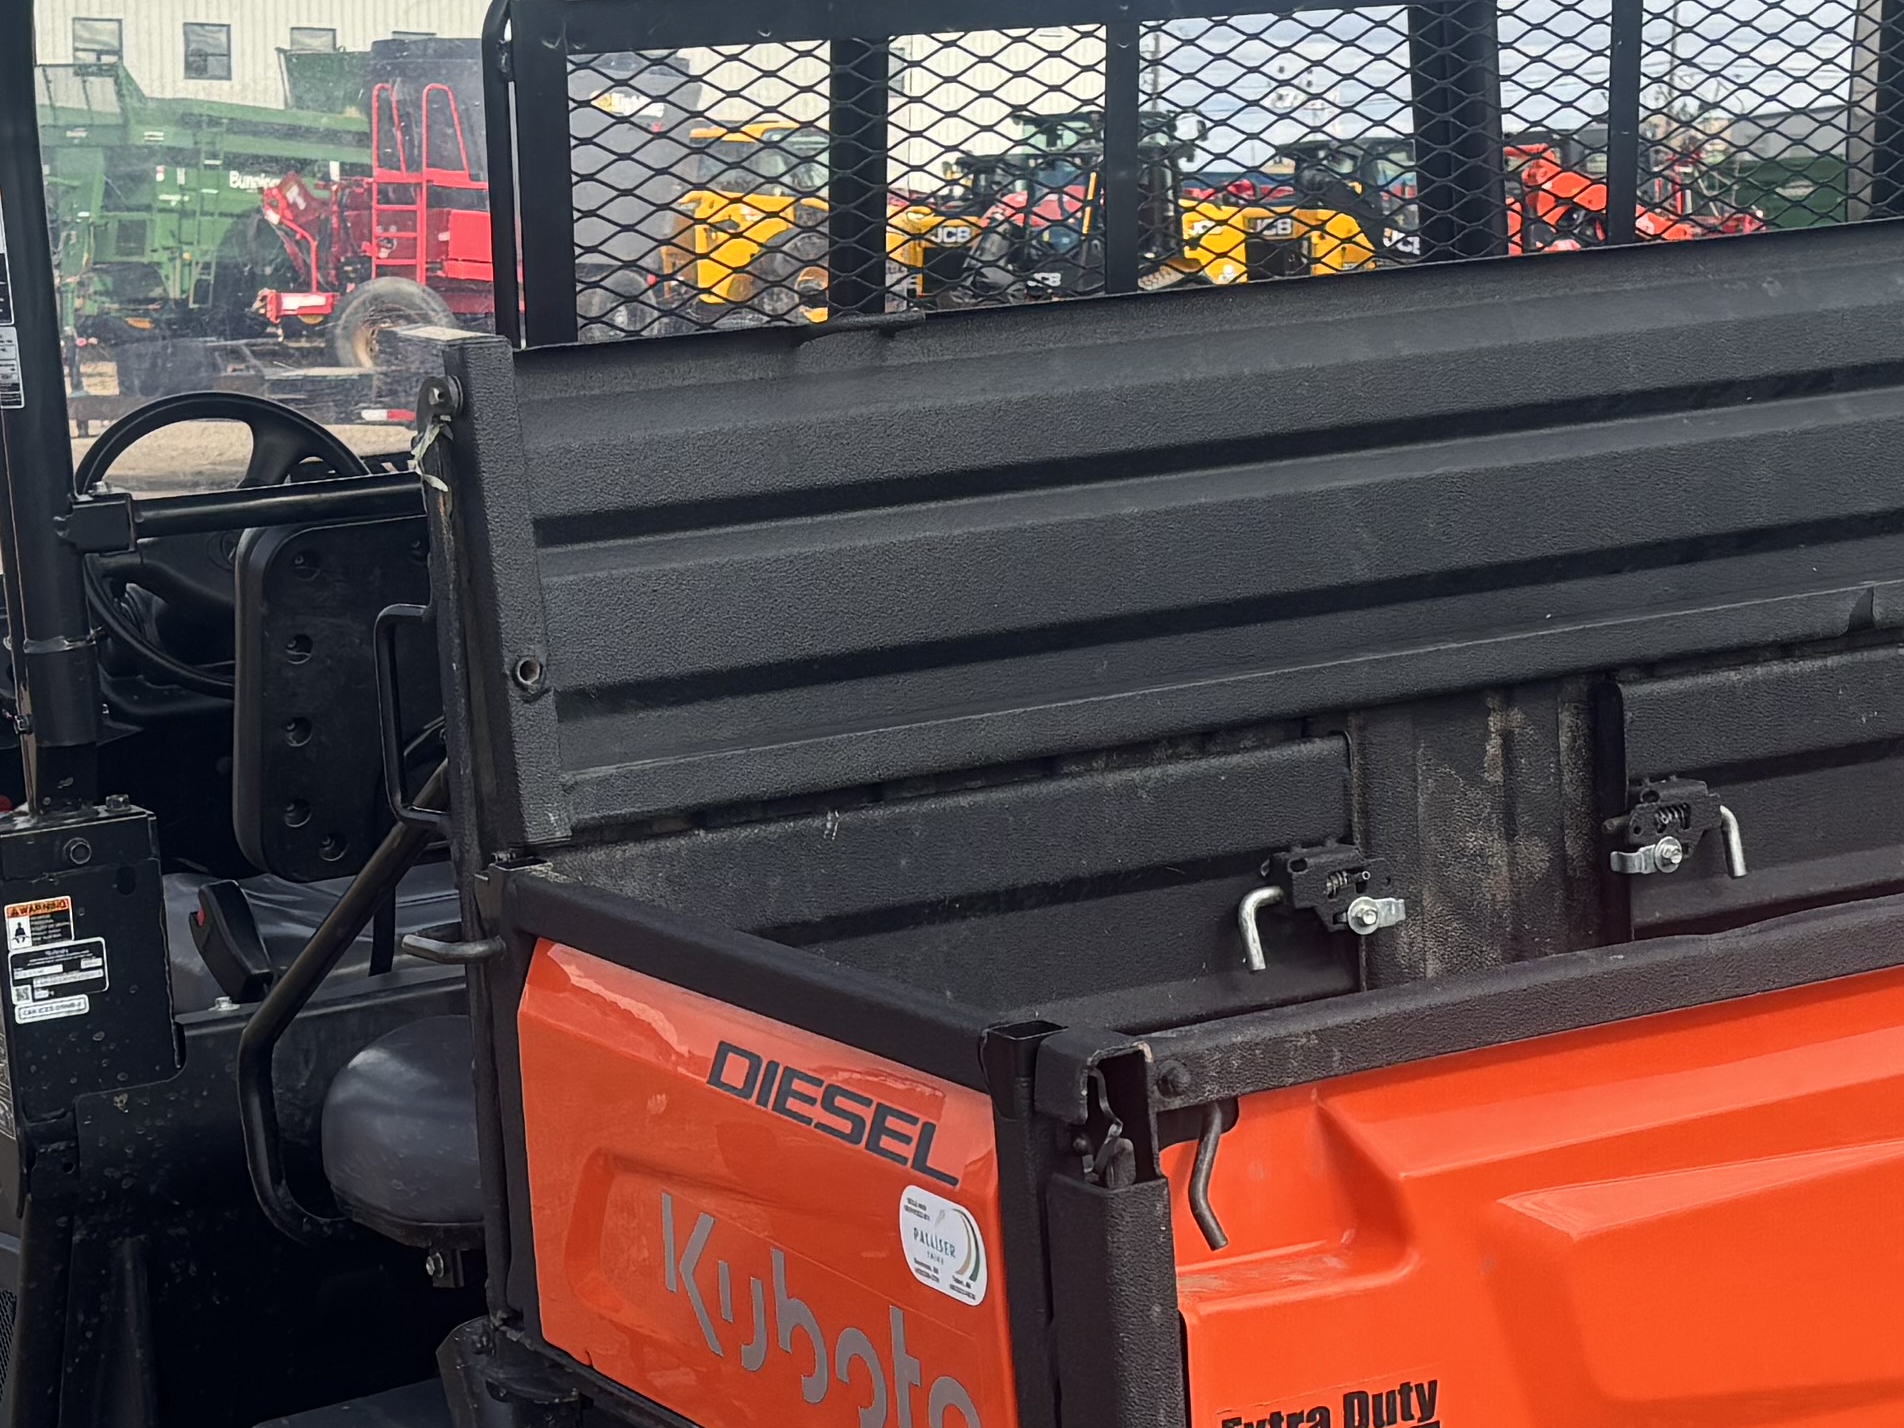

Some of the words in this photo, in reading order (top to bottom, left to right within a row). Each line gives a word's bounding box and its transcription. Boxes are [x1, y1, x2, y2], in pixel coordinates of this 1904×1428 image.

[930, 226, 972, 243] JCB
[706, 1040, 959, 1187] DIESEL
[913, 1227, 956, 1258] PALLISER
